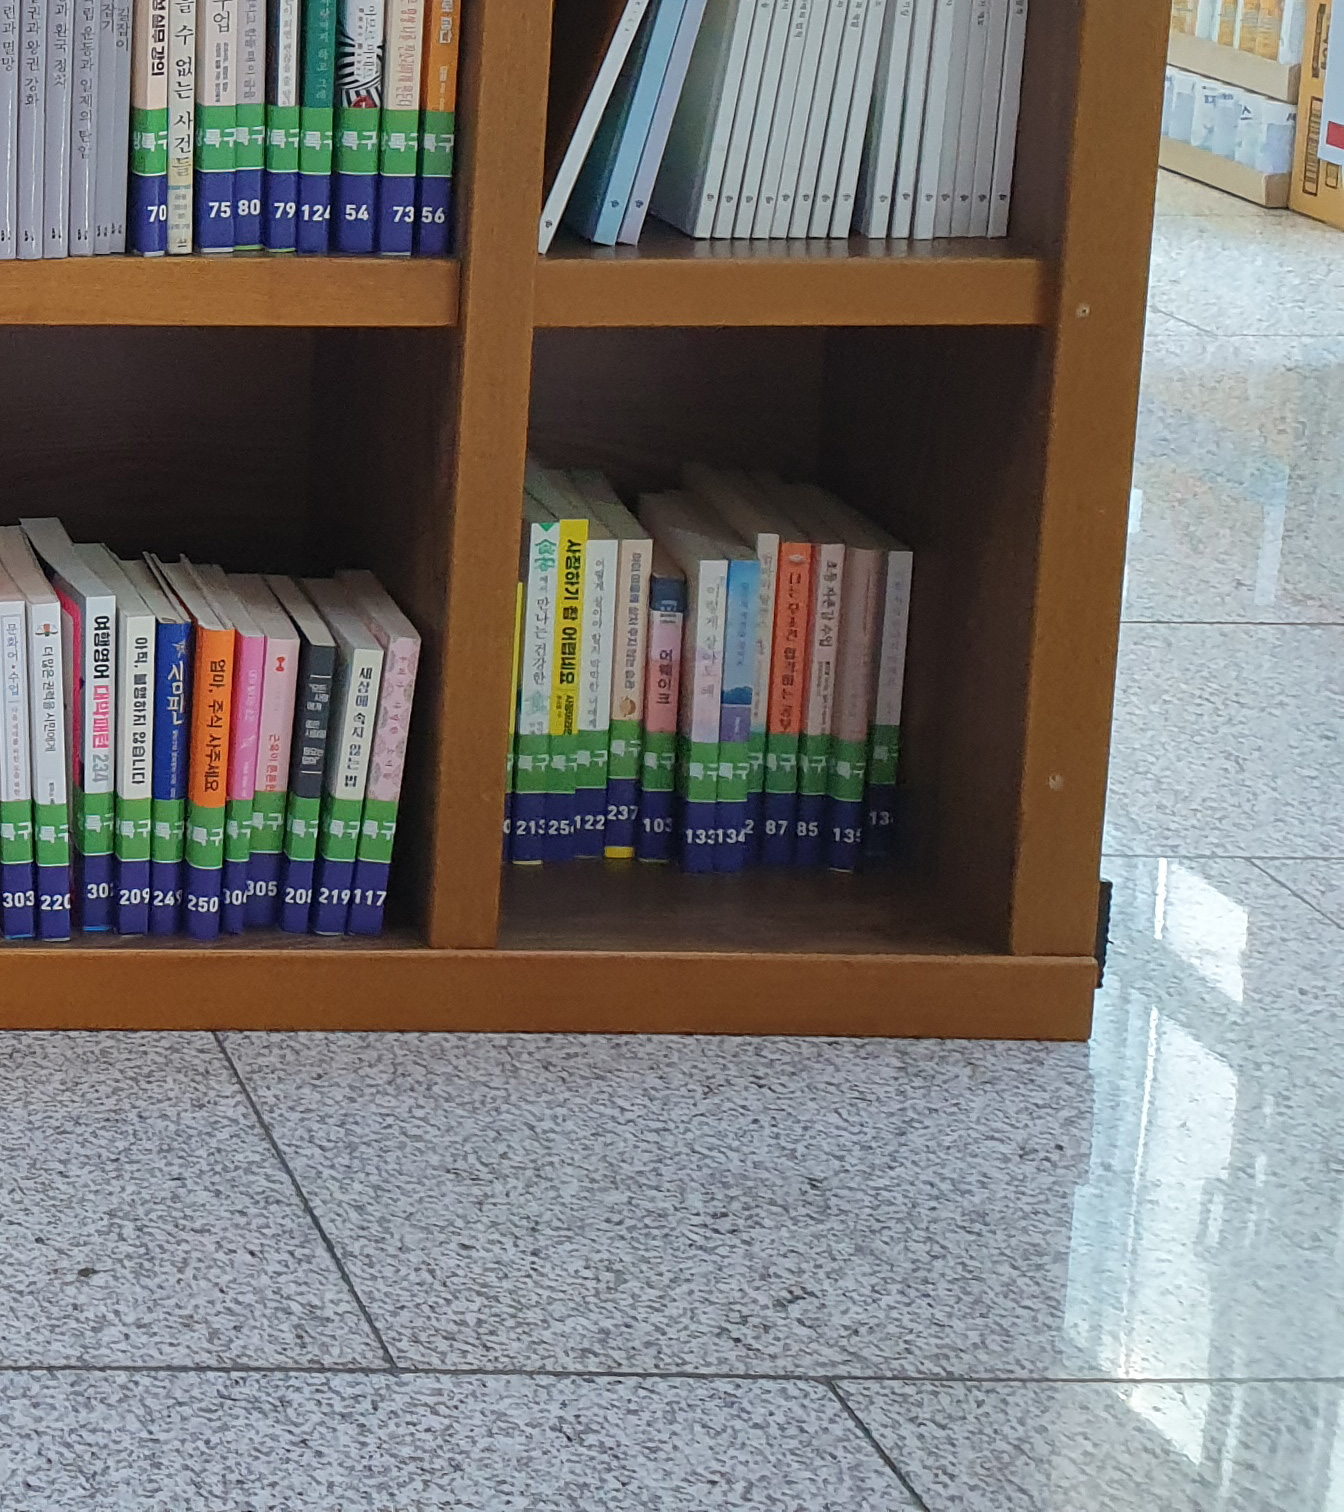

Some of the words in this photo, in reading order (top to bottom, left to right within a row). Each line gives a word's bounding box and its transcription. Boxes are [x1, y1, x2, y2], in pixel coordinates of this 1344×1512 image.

[152, 14, 166, 43] 실무
[174, 25, 194, 45] 수
[151, 46, 165, 76] 강의
[173, 56, 193, 100] 없는
[172, 111, 193, 178] 사건들
[209, 202, 231, 218] 75
[238, 199, 260, 215] 80
[274, 202, 296, 218] 79
[345, 205, 369, 221] 54
[421, 207, 445, 224] 56
[564, 539, 582, 601] 사장하기
[562, 606, 579, 620] 참
[93, 615, 110, 679] 여행영어
[560, 626, 578, 685] 어렵네요
[208, 659, 226, 694] 엄마,
[166, 660, 185, 726] 심판
[92, 685, 109, 749] 대박패턴
[206, 699, 224, 731] 주식
[92, 754, 109, 783] 234
[204, 734, 222, 792] 사주세요
[575, 815, 604, 830] 122
[607, 805, 638, 821] 237
[765, 821, 788, 835] 87
[247, 881, 277, 898] 305
[319, 888, 349, 904] 219
[353, 889, 387, 906] 117
[187, 895, 219, 912] 250
